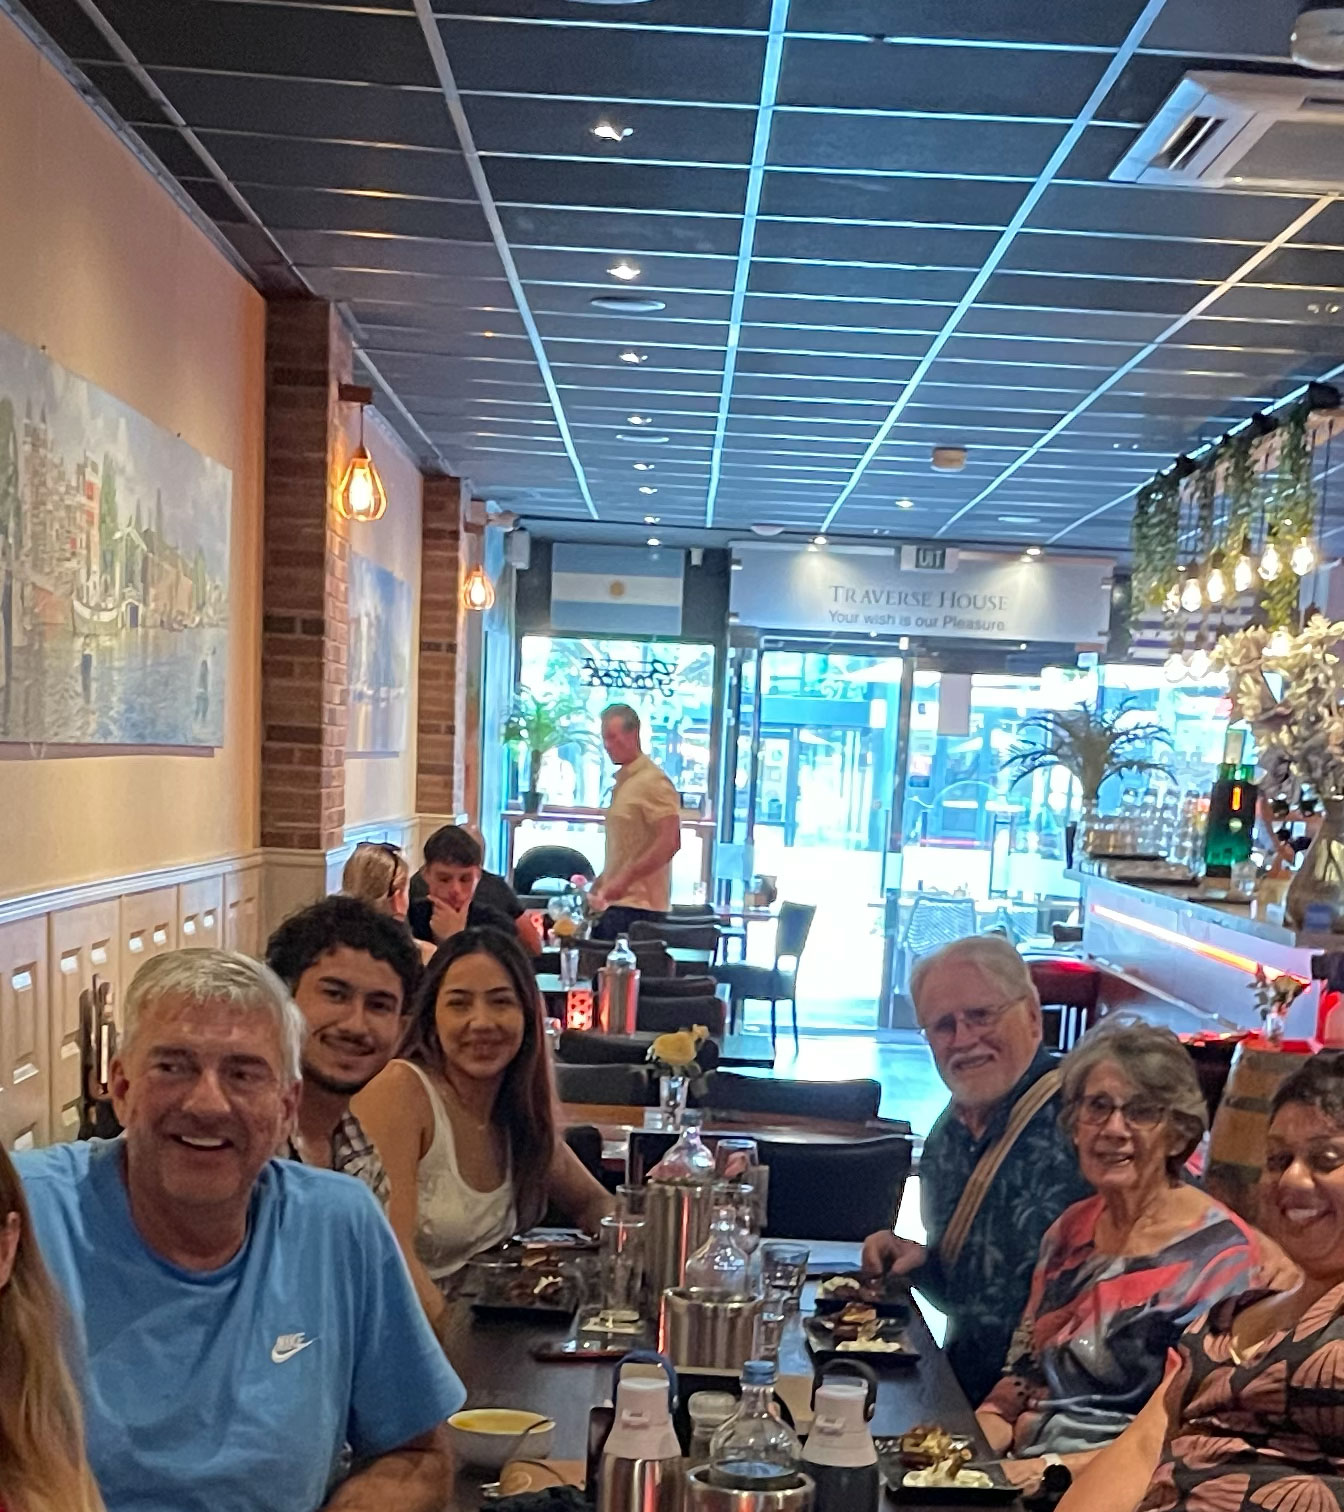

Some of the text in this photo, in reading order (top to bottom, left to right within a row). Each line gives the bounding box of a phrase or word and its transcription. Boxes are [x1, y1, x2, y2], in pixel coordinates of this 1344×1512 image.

[919, 549, 942, 567] UIT
[829, 585, 1008, 611] TRAVERSE HOUSE
[829, 609, 1006, 631] Your wish is our Pleasure
[275, 1332, 305, 1351] NIKE
